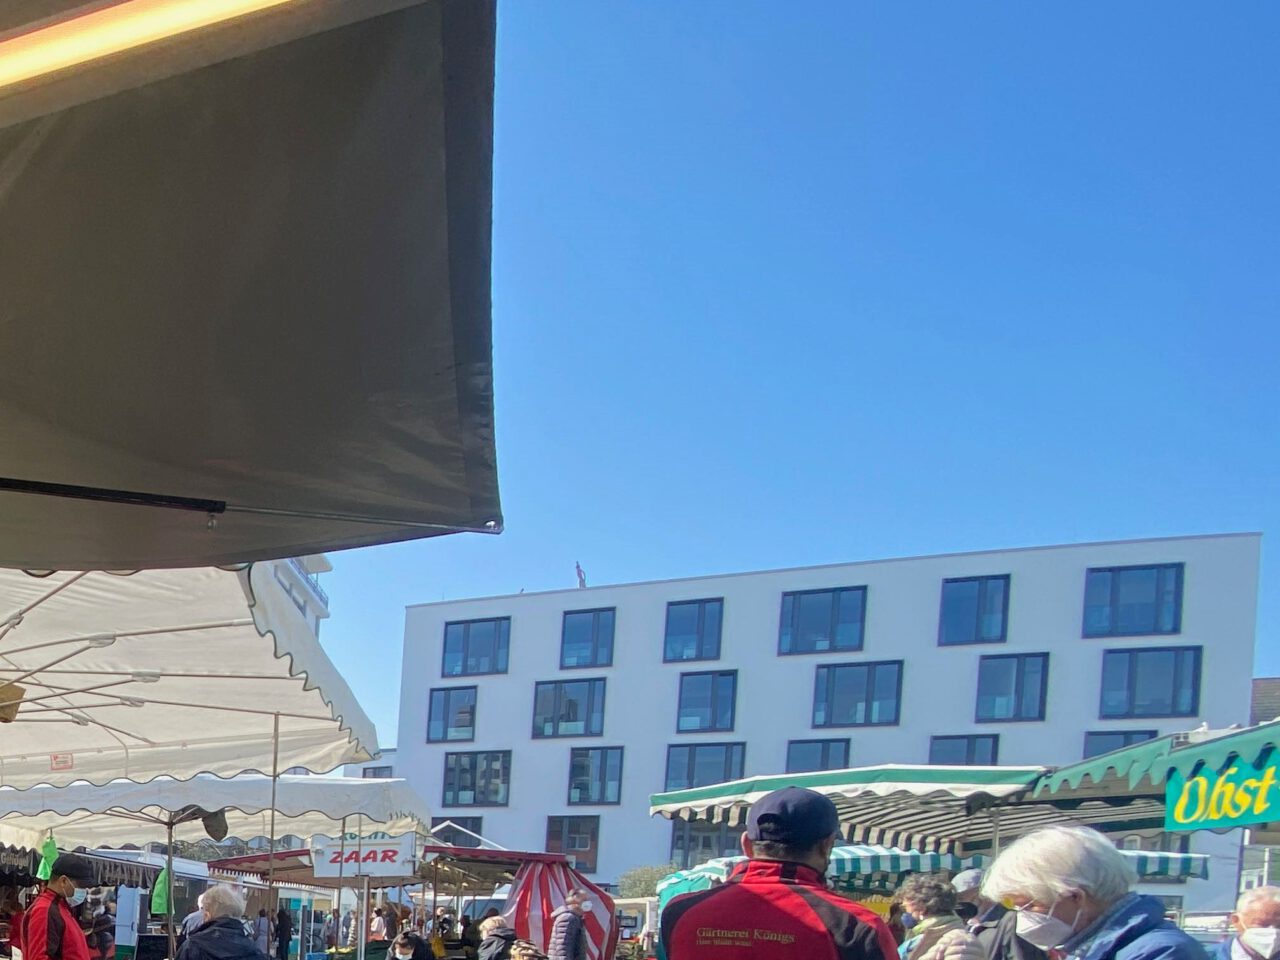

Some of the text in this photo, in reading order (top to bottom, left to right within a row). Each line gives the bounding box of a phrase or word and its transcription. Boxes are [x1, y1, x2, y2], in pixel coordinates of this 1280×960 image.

[1174, 765, 1276, 823] Obst
[329, 849, 399, 864] ZAAR
[696, 927, 749, 938] Gärtnerei
[753, 928, 796, 944] Königs
